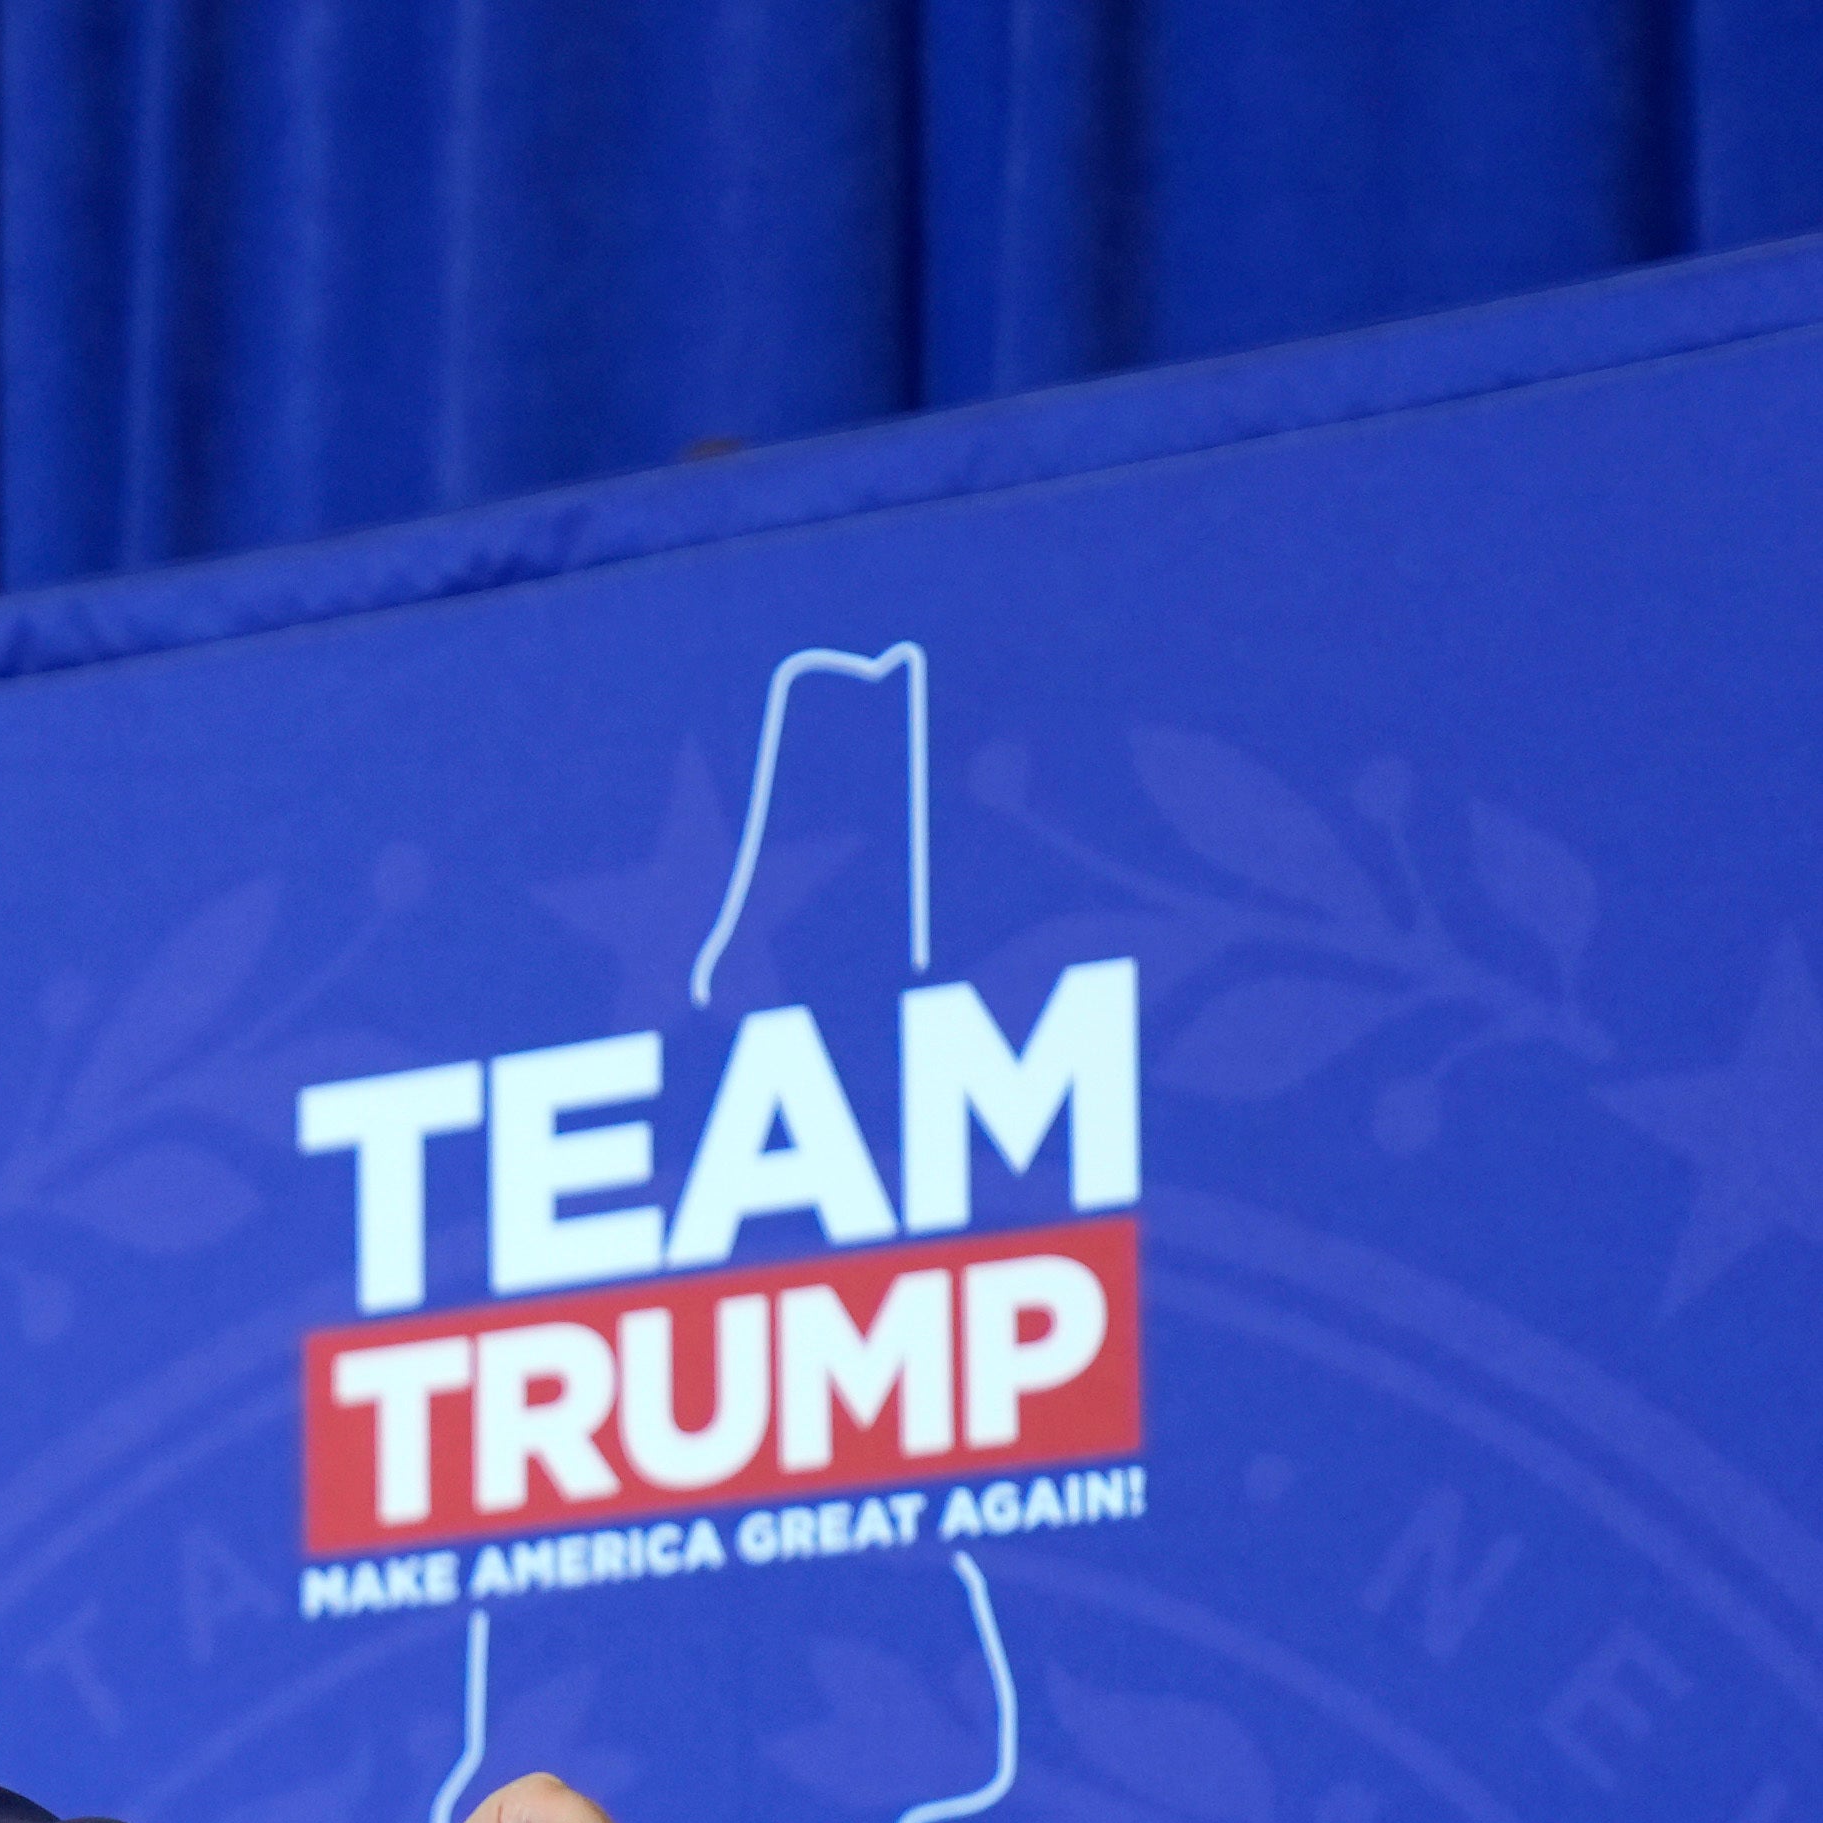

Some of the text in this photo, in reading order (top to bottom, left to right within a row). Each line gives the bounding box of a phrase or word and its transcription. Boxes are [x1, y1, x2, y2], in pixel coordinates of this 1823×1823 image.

[298, 957, 1140, 1315] TEAM
[333, 1253, 1109, 1526] TRUMP
[300, 1468, 1147, 1618] MAKE AMERICA GREAT AGAIN!
